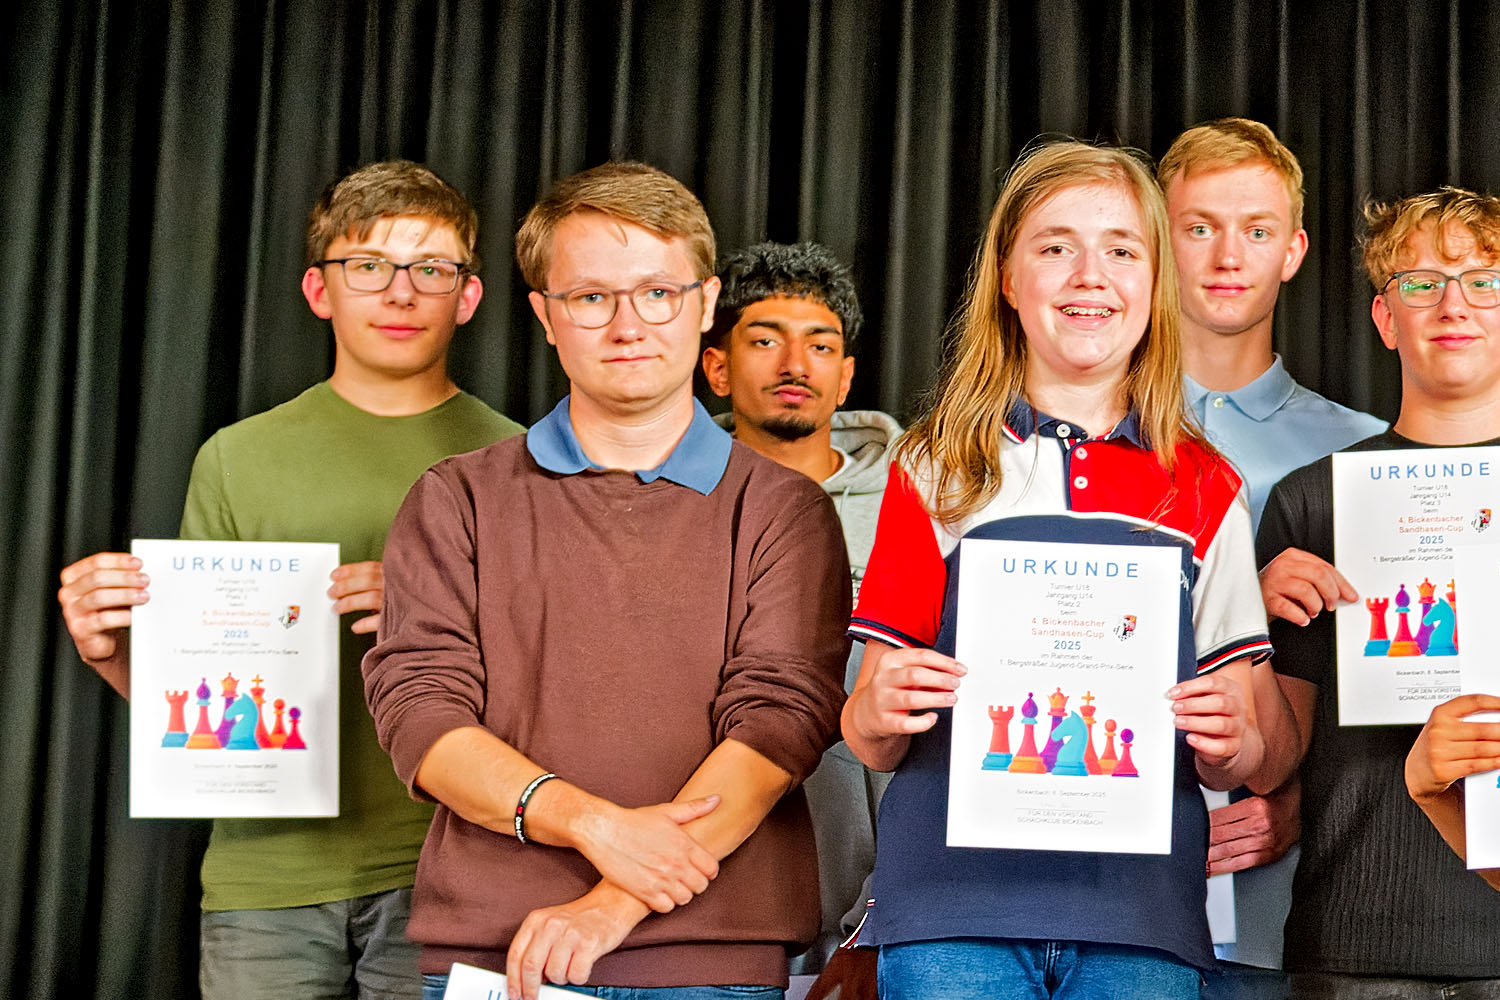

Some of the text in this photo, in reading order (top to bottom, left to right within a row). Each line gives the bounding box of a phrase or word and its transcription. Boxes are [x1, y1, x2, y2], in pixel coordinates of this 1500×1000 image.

[1370, 461, 1490, 480] URKUNDE
[1398, 513, 1464, 524] 4. Bickenbacher
[1398, 523, 1464, 534] Sandhasen-Cup
[1419, 534, 1444, 544] 2025
[1002, 558, 1139, 578] URKUNDE
[1031, 616, 1105, 627] 4. Bickenbacher
[1030, 627, 1105, 639] Sandhasen-Cup
[1053, 639, 1082, 650] 2025
